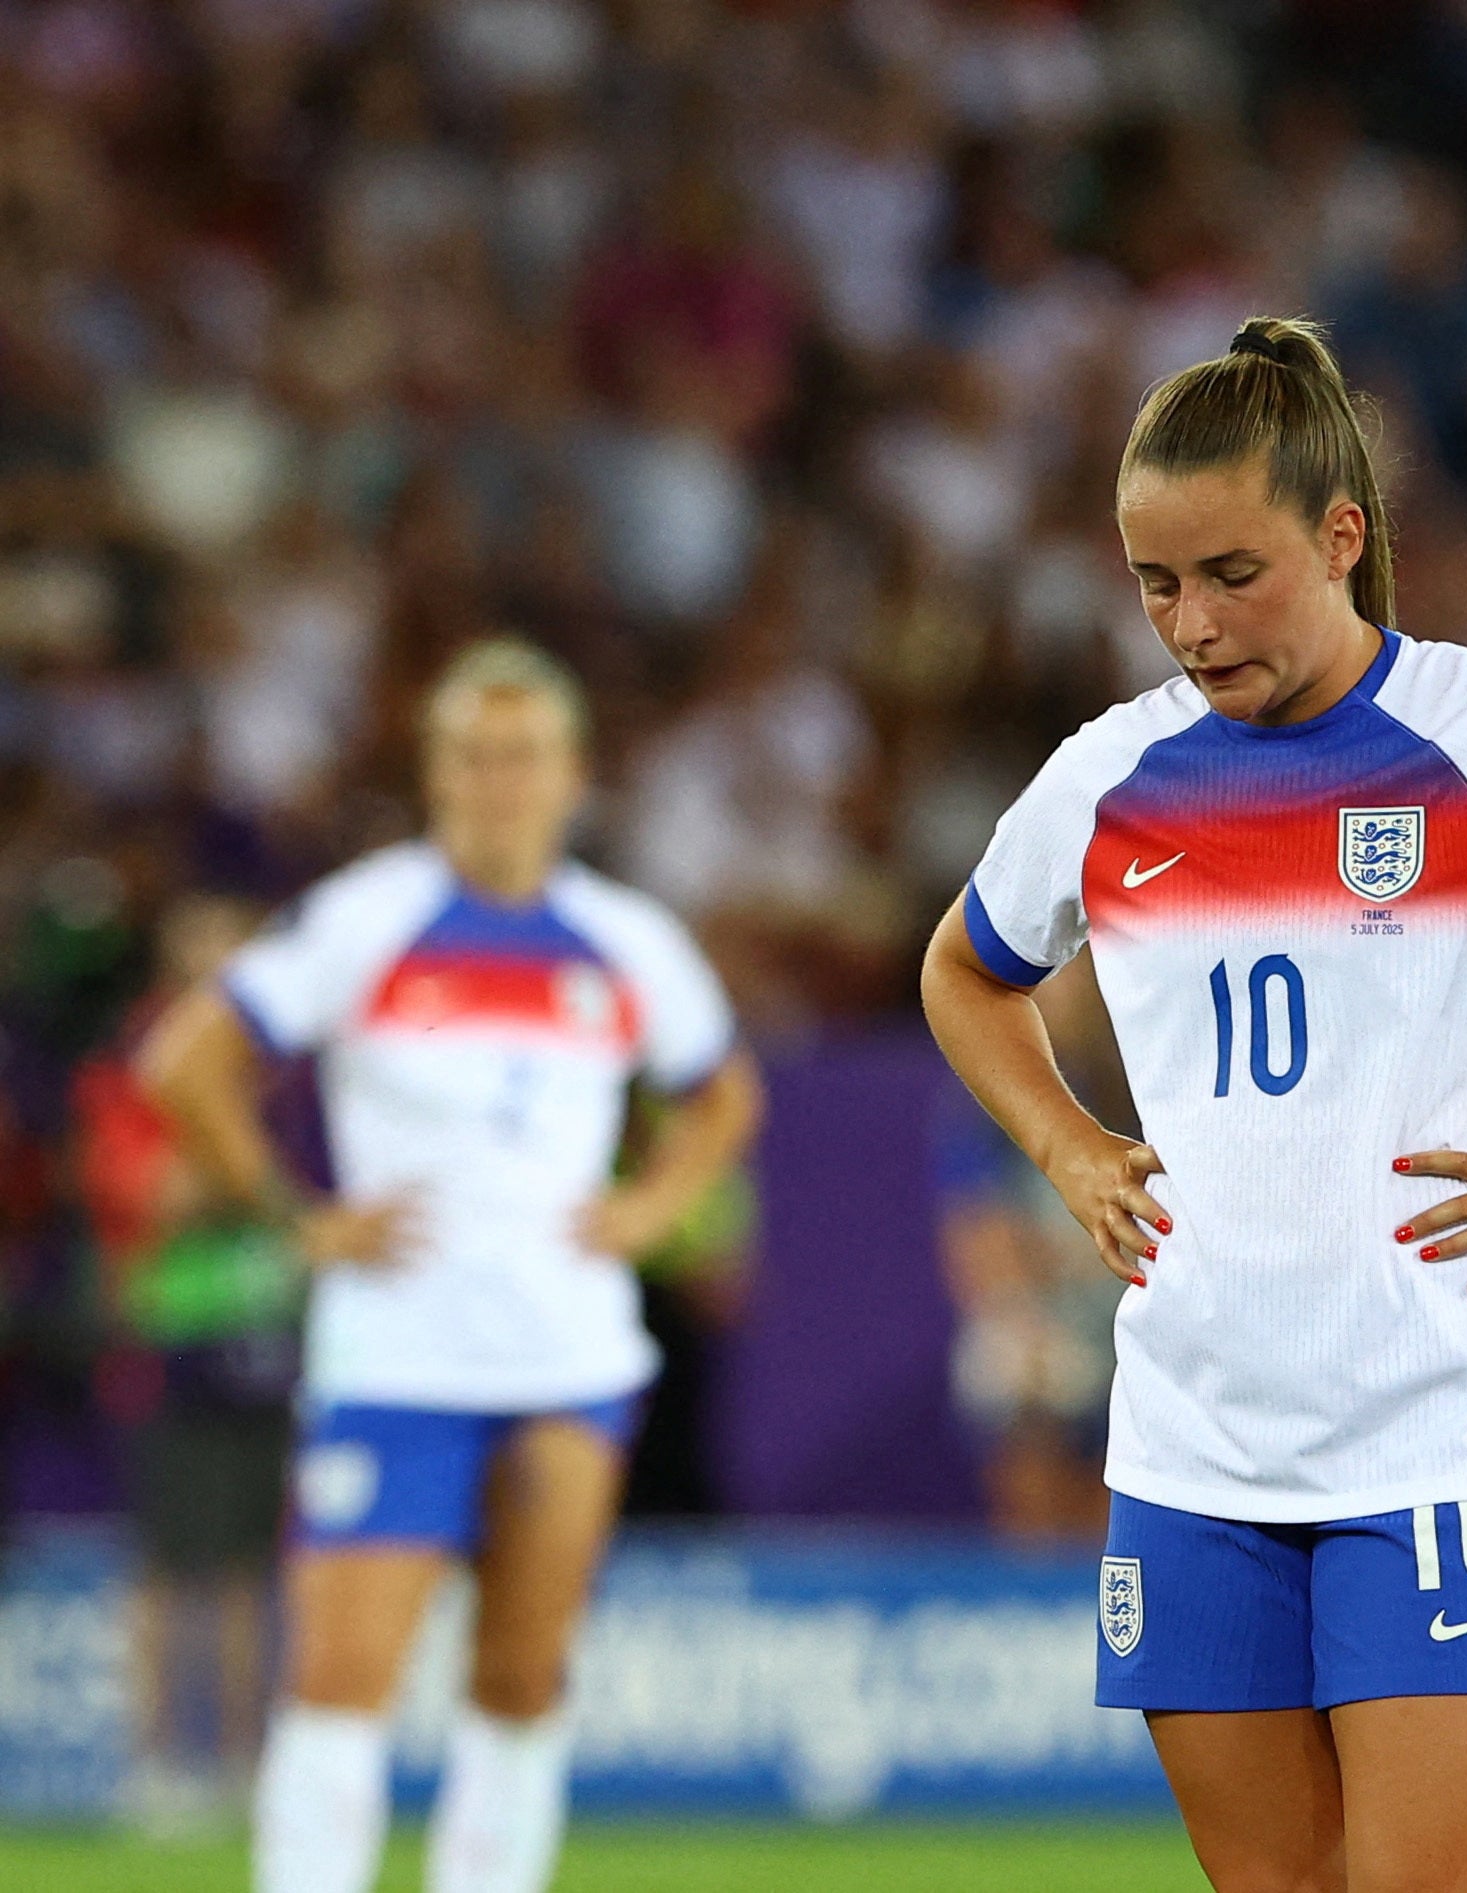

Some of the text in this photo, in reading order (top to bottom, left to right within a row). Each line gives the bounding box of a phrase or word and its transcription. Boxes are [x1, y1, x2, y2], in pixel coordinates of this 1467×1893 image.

[1362, 909, 1393, 921] FRANCE
[1350, 923, 1404, 935] 5 JULY 2025
[1209, 953, 1308, 1098] 10
